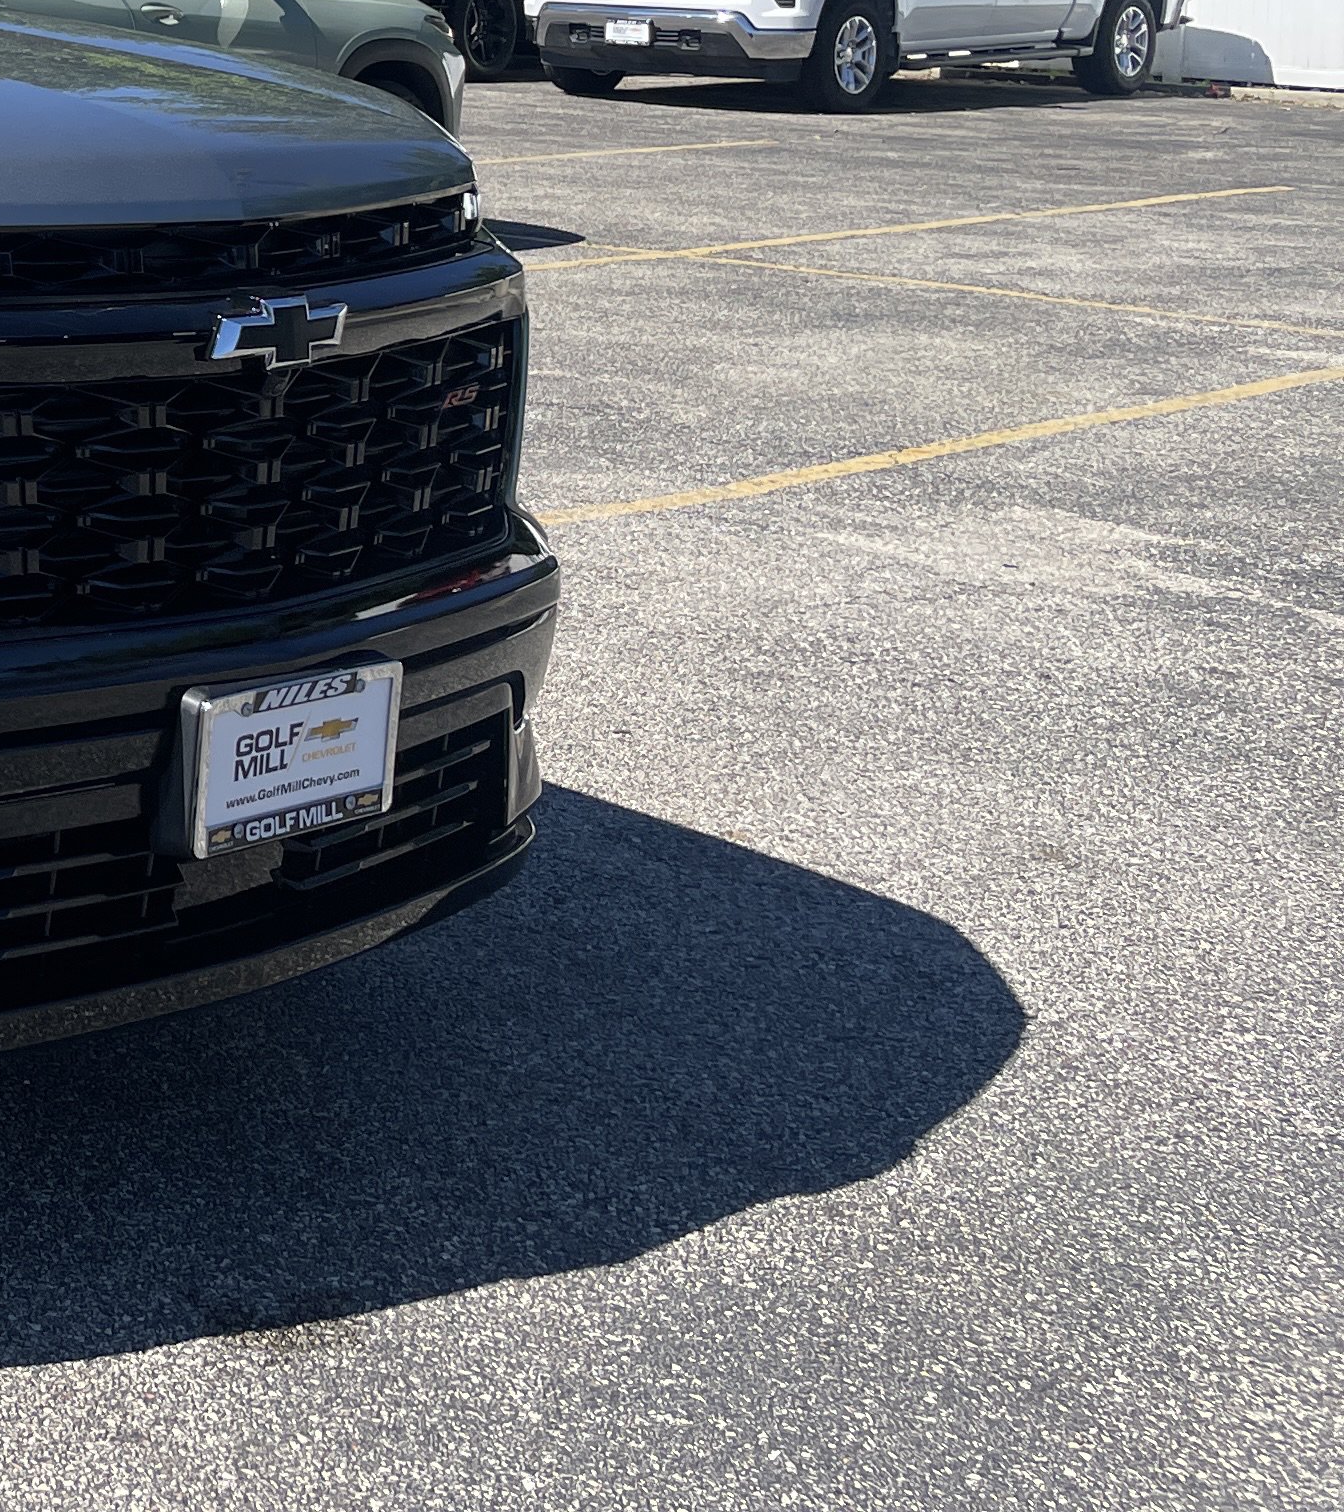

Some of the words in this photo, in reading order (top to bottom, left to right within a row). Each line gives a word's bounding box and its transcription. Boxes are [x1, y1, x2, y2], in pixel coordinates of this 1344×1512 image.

[444, 385, 480, 408] RS
[259, 674, 352, 712] NILES
[235, 721, 305, 758] GOLF
[234, 749, 289, 782] MILL
[226, 768, 360, 809] www.GolfMillChevy.com
[245, 816, 298, 842] GOLF
[298, 801, 344, 829] MILL
